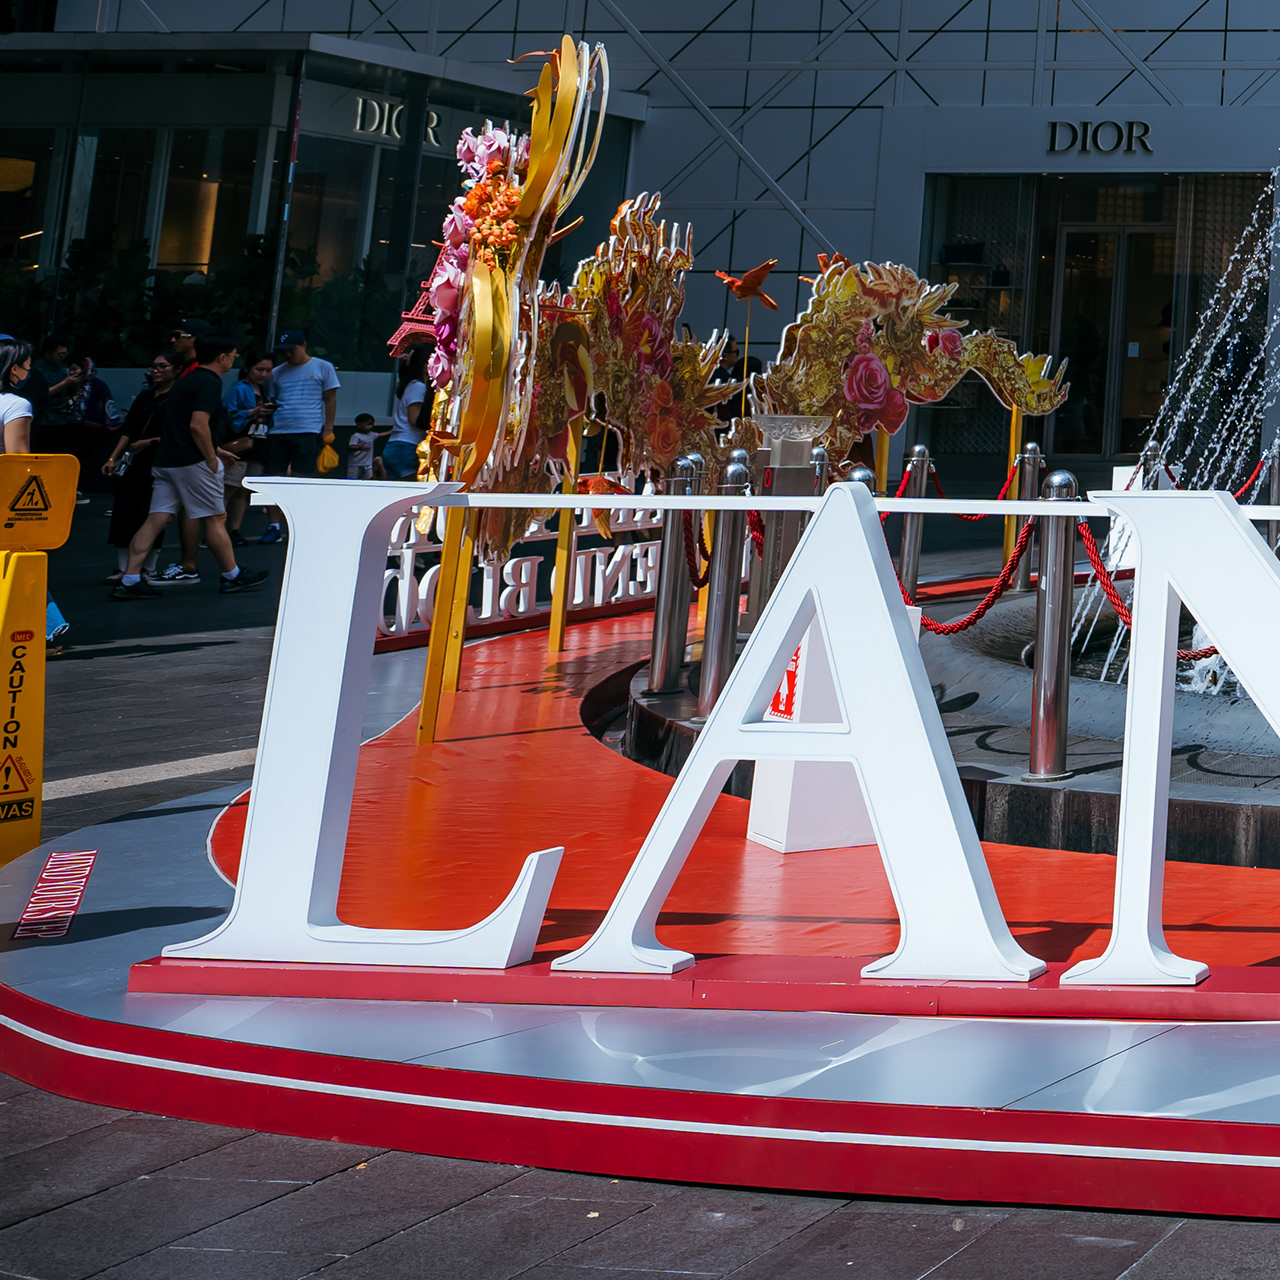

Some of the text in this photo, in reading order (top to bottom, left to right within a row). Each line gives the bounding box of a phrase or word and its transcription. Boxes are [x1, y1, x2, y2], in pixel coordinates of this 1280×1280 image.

[1046, 121, 1154, 154] DIOR
[3, 645, 28, 750] CAUTION
[0, 801, 33, 819] WAS
[14, 849, 98, 939] MIND YOUR STEP
